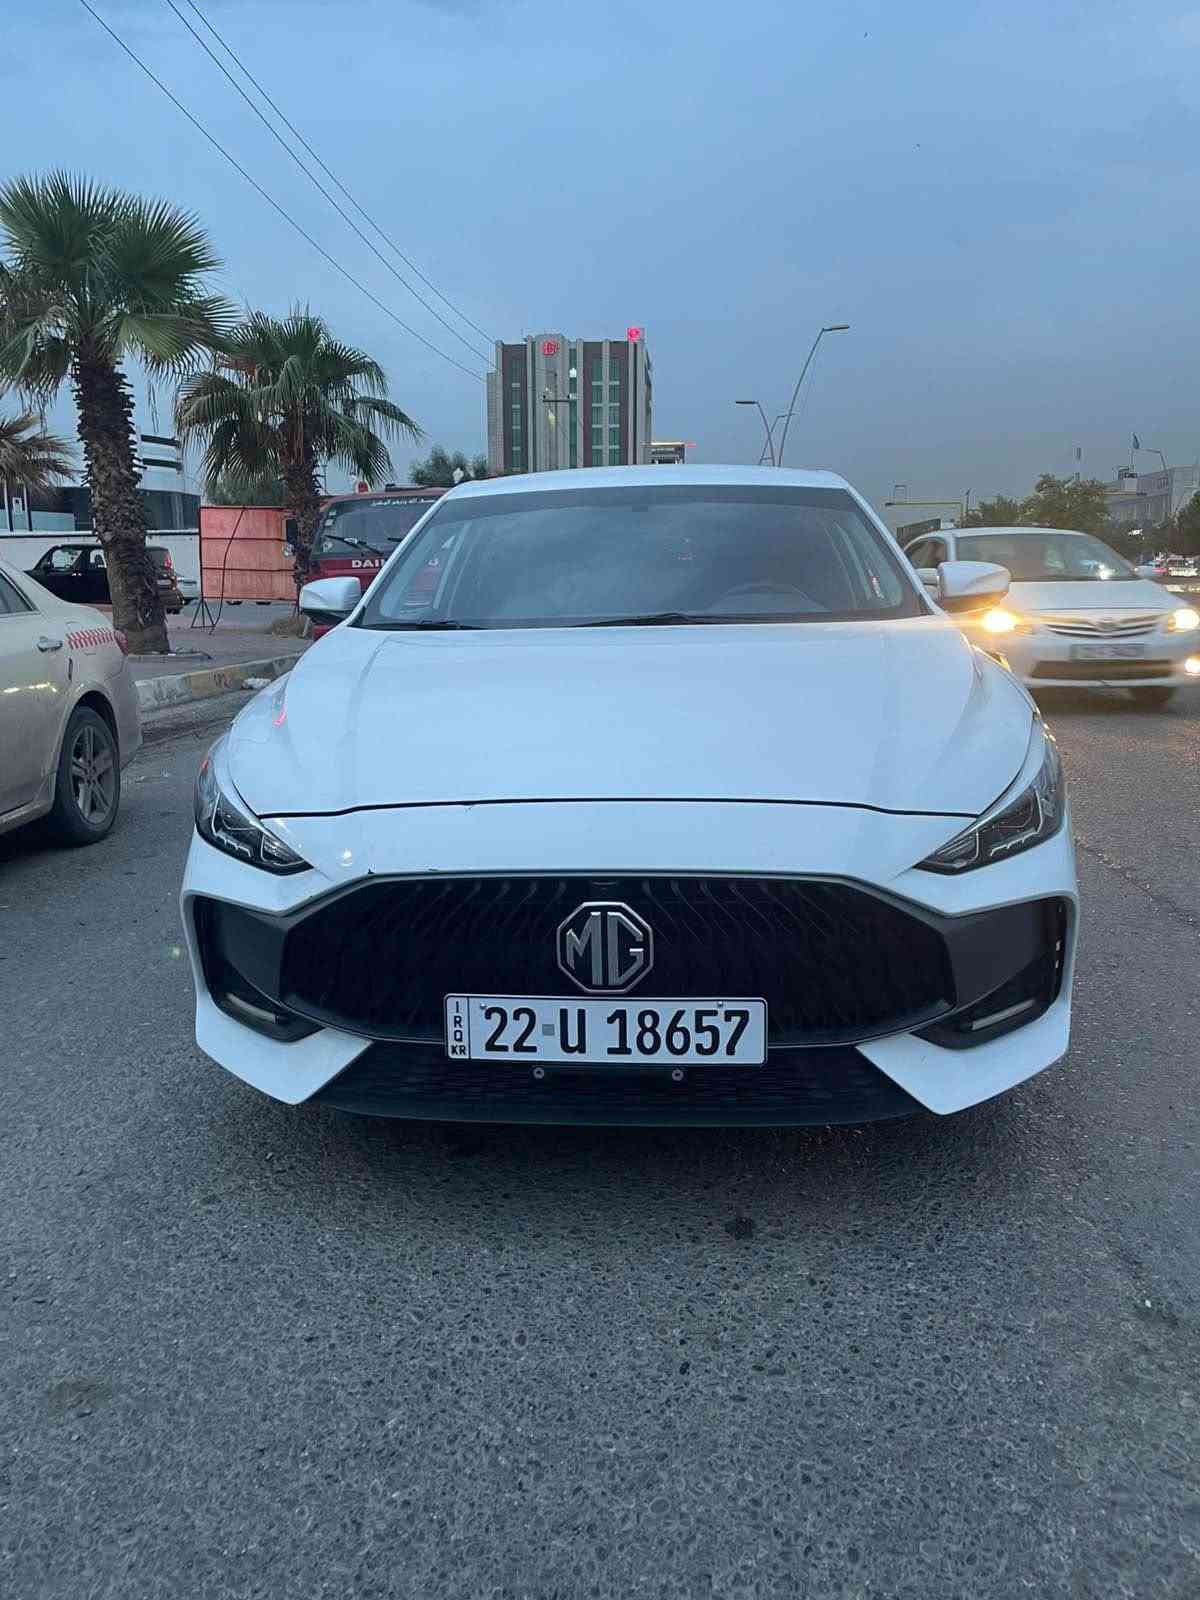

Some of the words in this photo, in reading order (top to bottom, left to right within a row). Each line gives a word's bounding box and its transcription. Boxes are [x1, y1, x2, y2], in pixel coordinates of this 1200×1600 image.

[566, 911, 644, 985] MG
[450, 1044, 466, 1056] KR
[484, 1006, 538, 1053] 22
[559, 1008, 586, 1054] U
[606, 1009, 751, 1056] 18657
